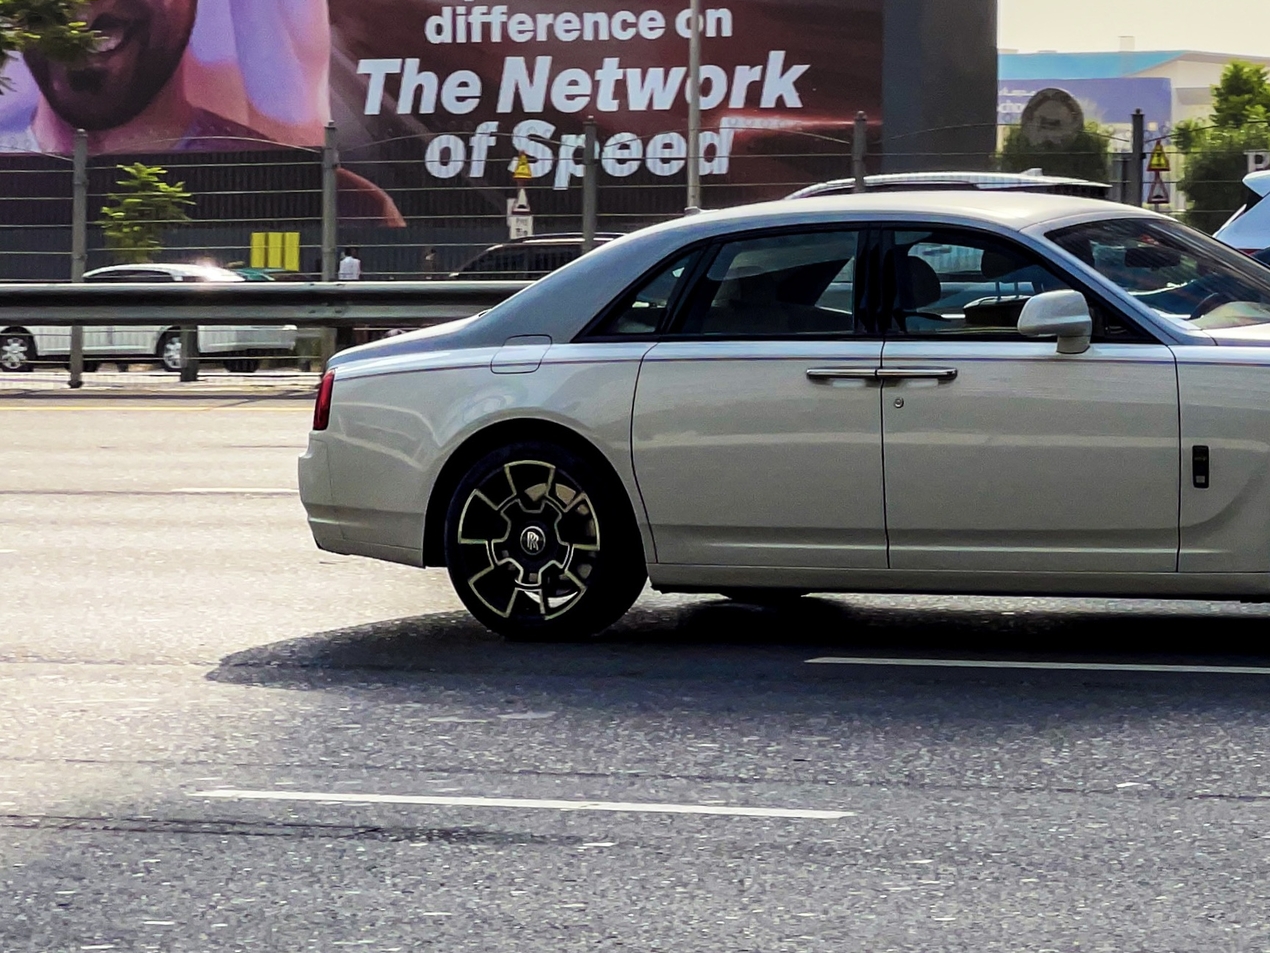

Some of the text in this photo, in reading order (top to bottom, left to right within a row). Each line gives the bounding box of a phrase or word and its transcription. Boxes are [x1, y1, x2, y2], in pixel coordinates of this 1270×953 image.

[424, 5, 734, 44] difference on
[356, 50, 811, 116] The Network
[424, 116, 736, 191] of Speed
